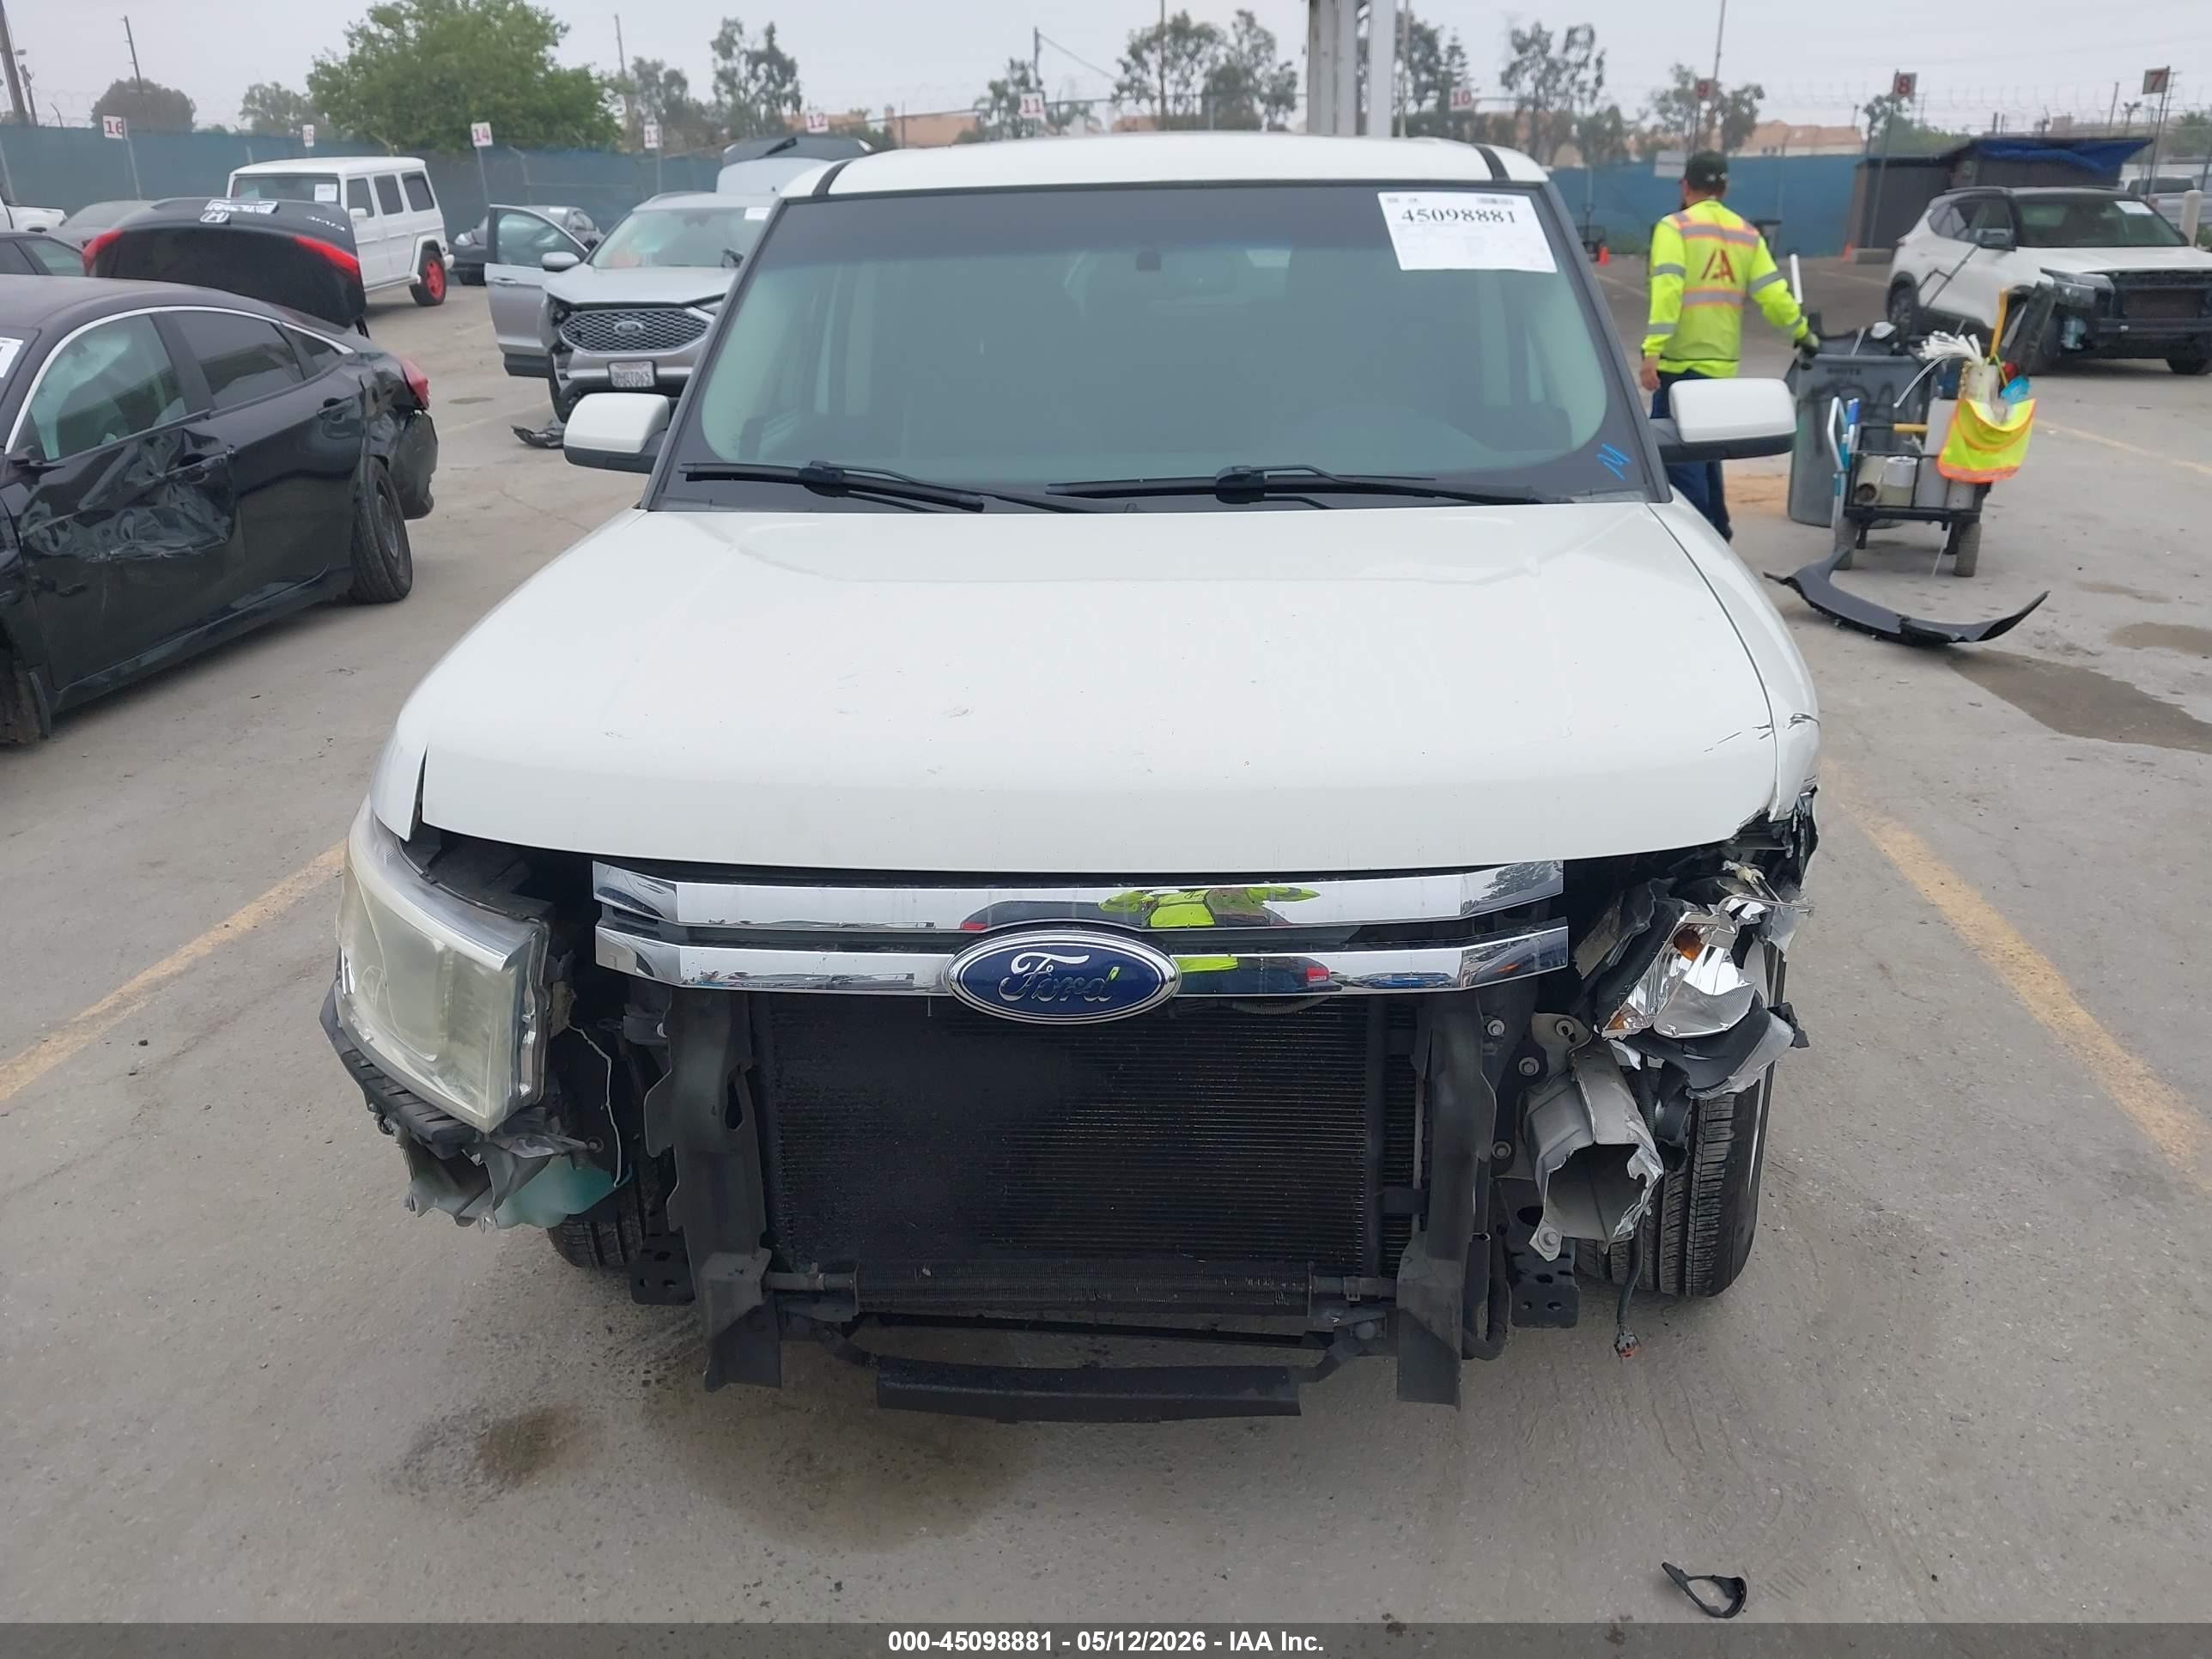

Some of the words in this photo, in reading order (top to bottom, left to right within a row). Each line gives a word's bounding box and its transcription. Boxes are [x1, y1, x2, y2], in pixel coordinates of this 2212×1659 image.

[1898, 75, 1911, 94] 8
[2149, 72, 2165, 90] 7
[1453, 90, 1472, 106] 10
[1697, 82, 1710, 99] 9
[1024, 99, 1040, 113] 11
[809, 112, 825, 129] 12
[474, 128, 489, 143] 14
[1401, 208, 1516, 223] 45098881
[998, 951, 1121, 1003] Ford
